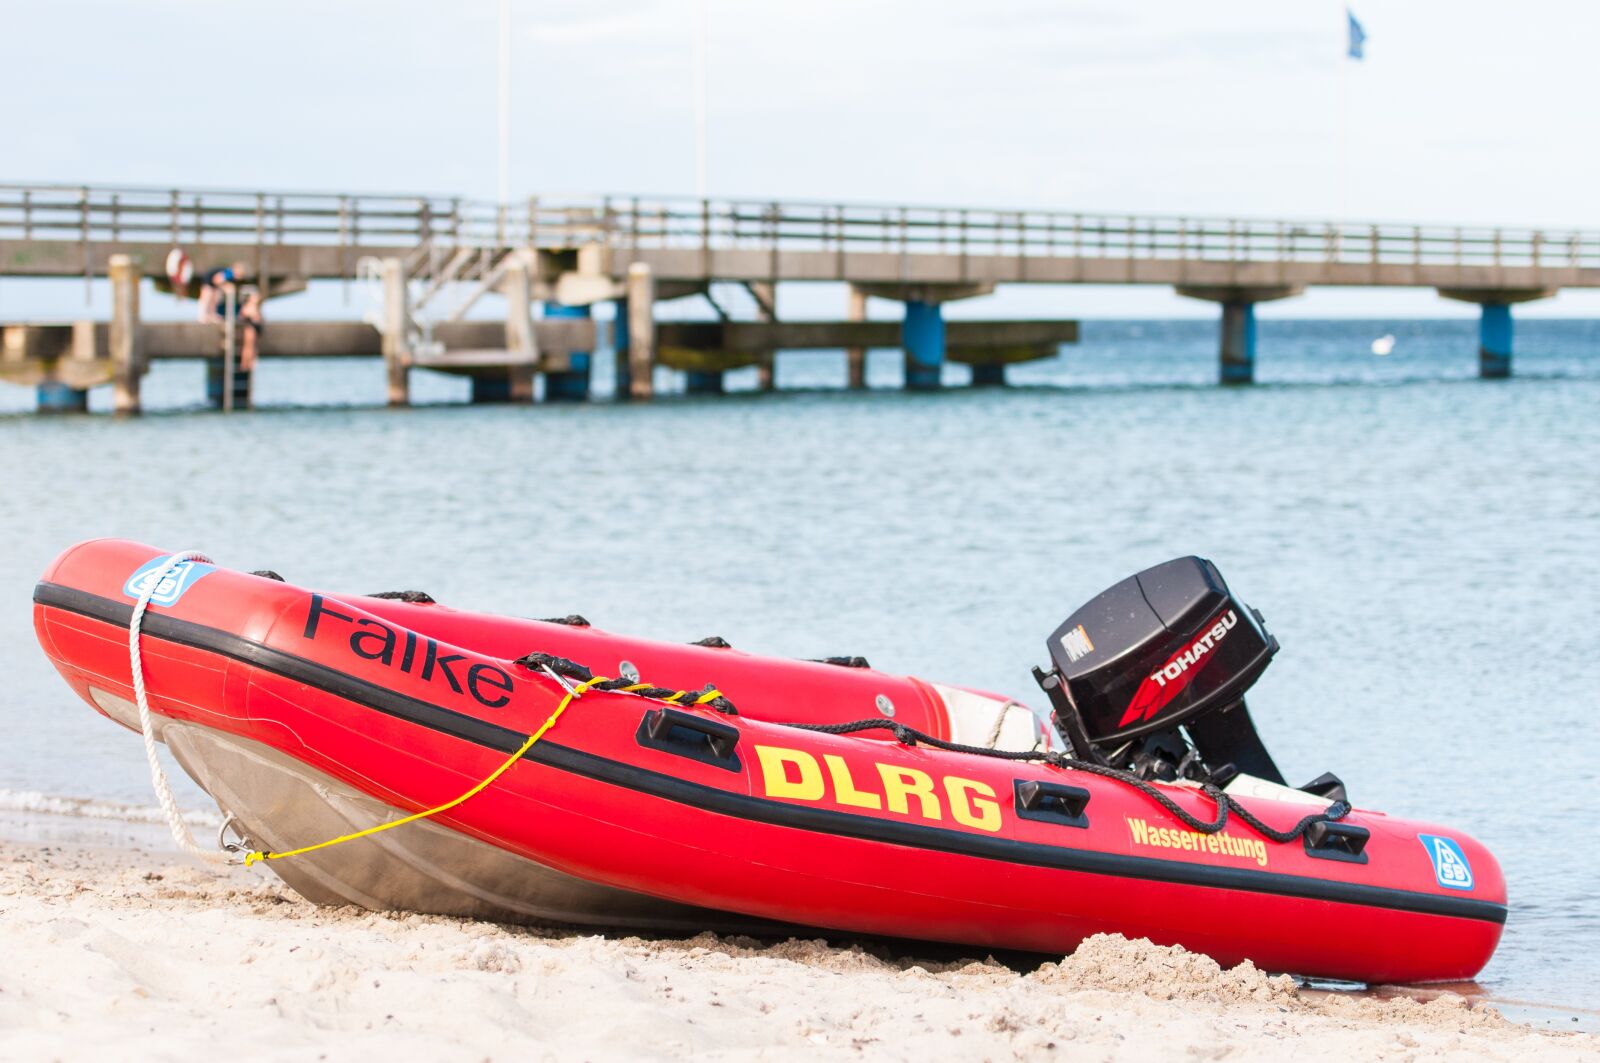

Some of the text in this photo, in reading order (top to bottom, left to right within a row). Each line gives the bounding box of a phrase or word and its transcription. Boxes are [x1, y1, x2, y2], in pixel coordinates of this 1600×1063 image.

[1150, 610, 1238, 687] TOHATSU
[754, 744, 1003, 833] DLRG
[1127, 817, 1268, 867] Wasserrettung
